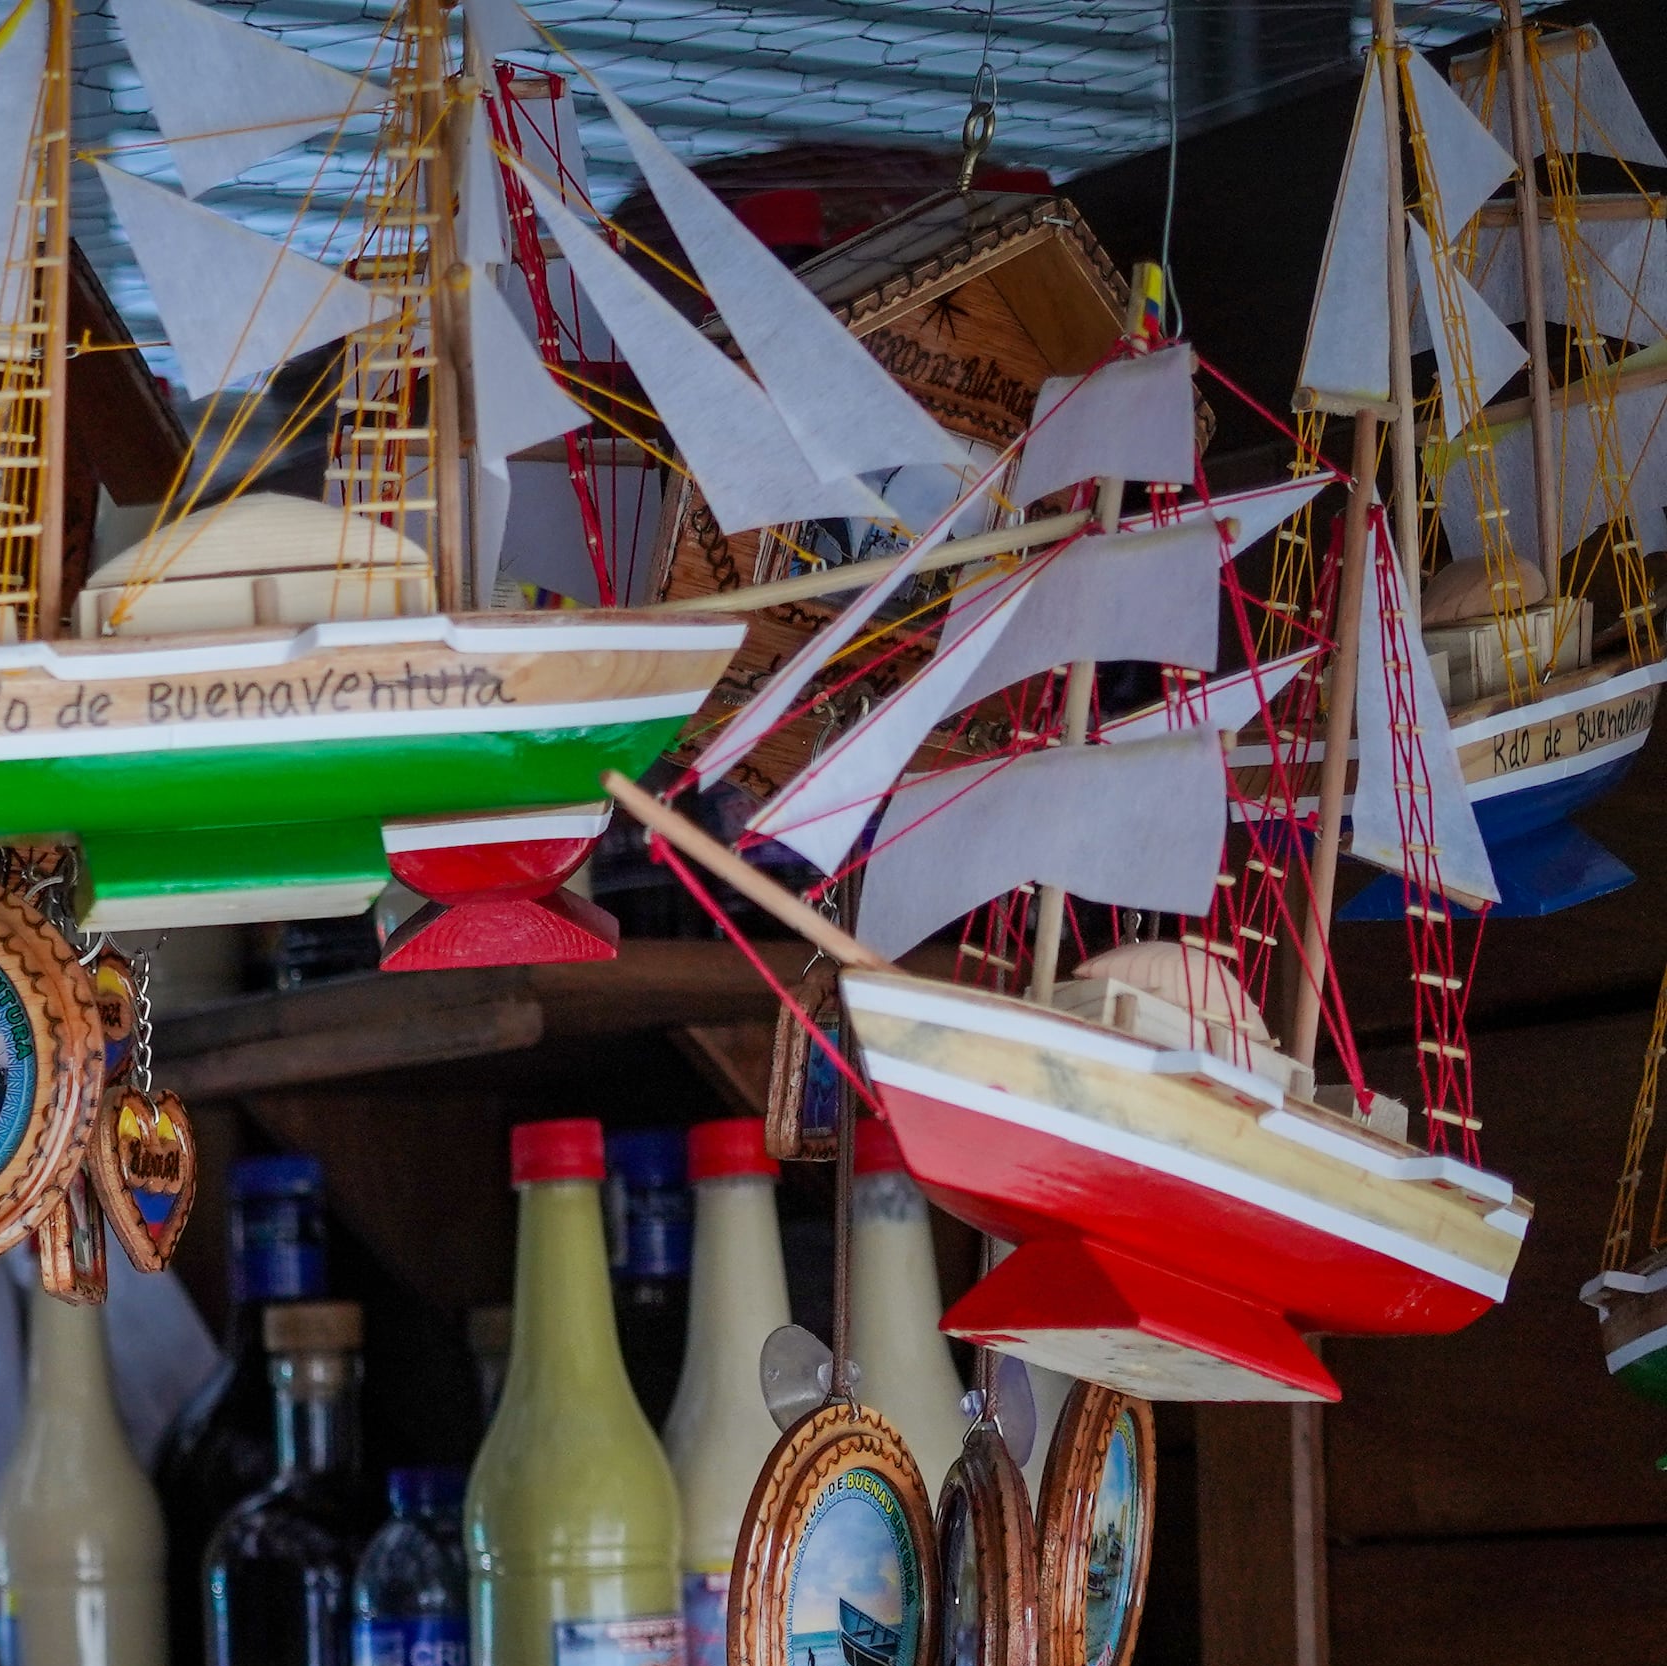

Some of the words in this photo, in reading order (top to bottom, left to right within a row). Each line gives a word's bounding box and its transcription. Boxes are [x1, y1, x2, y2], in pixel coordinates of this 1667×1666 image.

[56, 684, 113, 729] de
[147, 661, 517, 724] Buenaventura
[1543, 719, 1562, 762] de
[827, 1476, 844, 1495] DE
